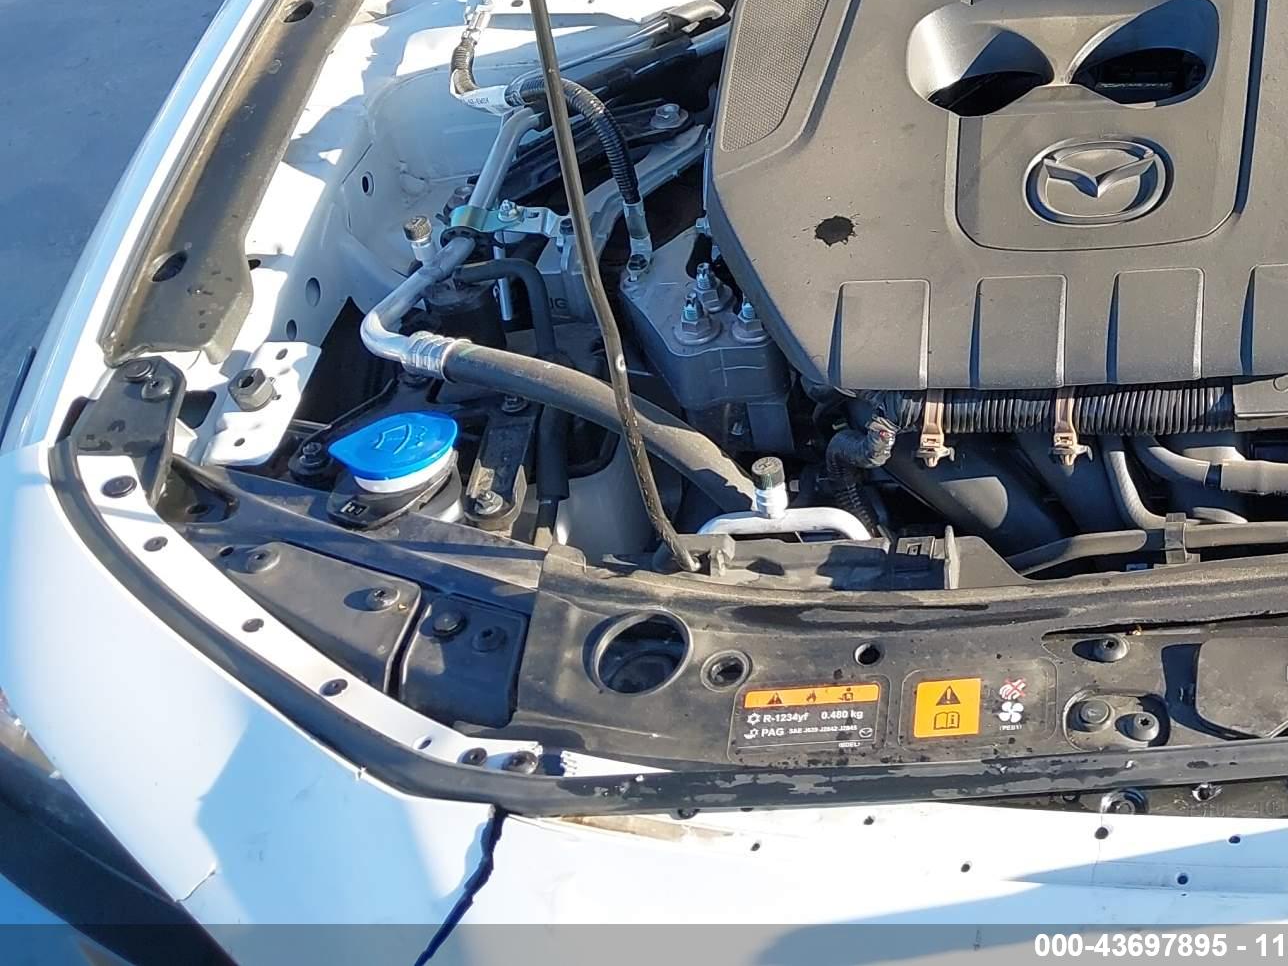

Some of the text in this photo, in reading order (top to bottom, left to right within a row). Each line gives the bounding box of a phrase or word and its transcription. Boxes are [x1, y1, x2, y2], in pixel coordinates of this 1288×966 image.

[762, 709, 864, 723] R-1234yf 0.480 kg
[760, 727, 785, 737] PAG
